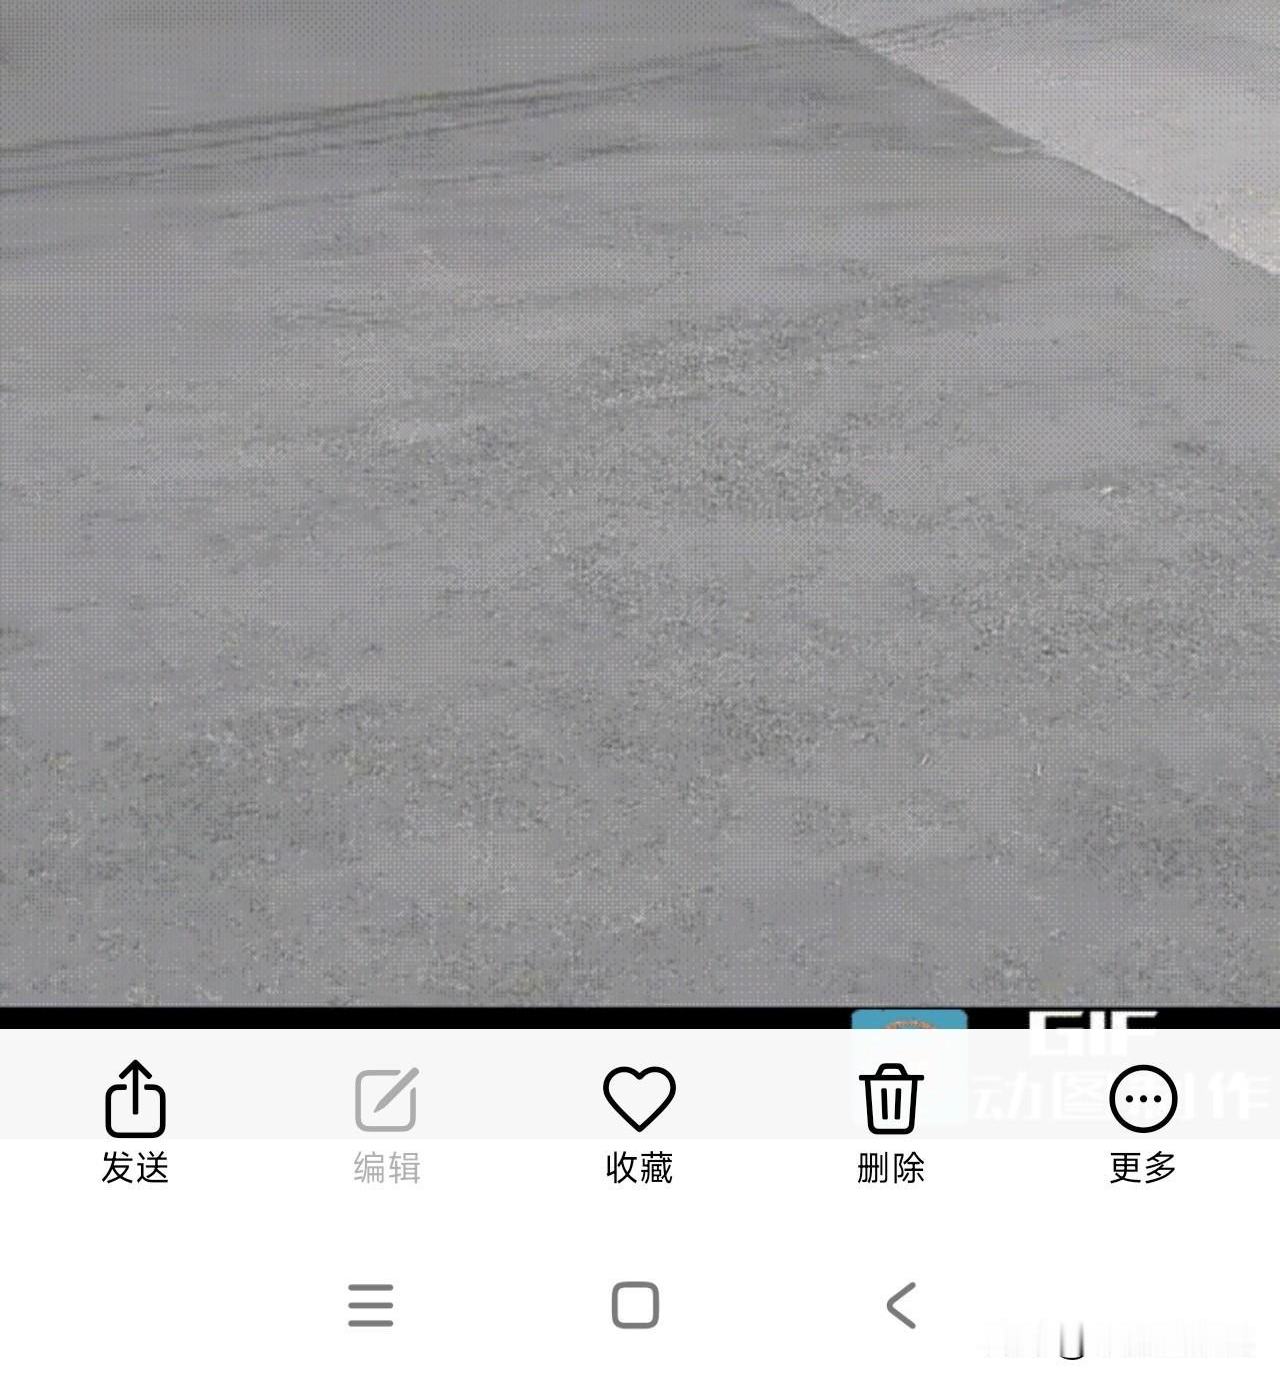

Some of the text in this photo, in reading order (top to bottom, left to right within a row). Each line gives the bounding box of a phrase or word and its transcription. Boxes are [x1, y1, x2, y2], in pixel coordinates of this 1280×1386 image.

[101, 1151, 169, 1185] 发送
[353, 1151, 421, 1184] 编辑
[606, 1151, 673, 1185] 收藏
[857, 1151, 925, 1185] 删除
[1109, 1151, 1176, 1185] 更多
